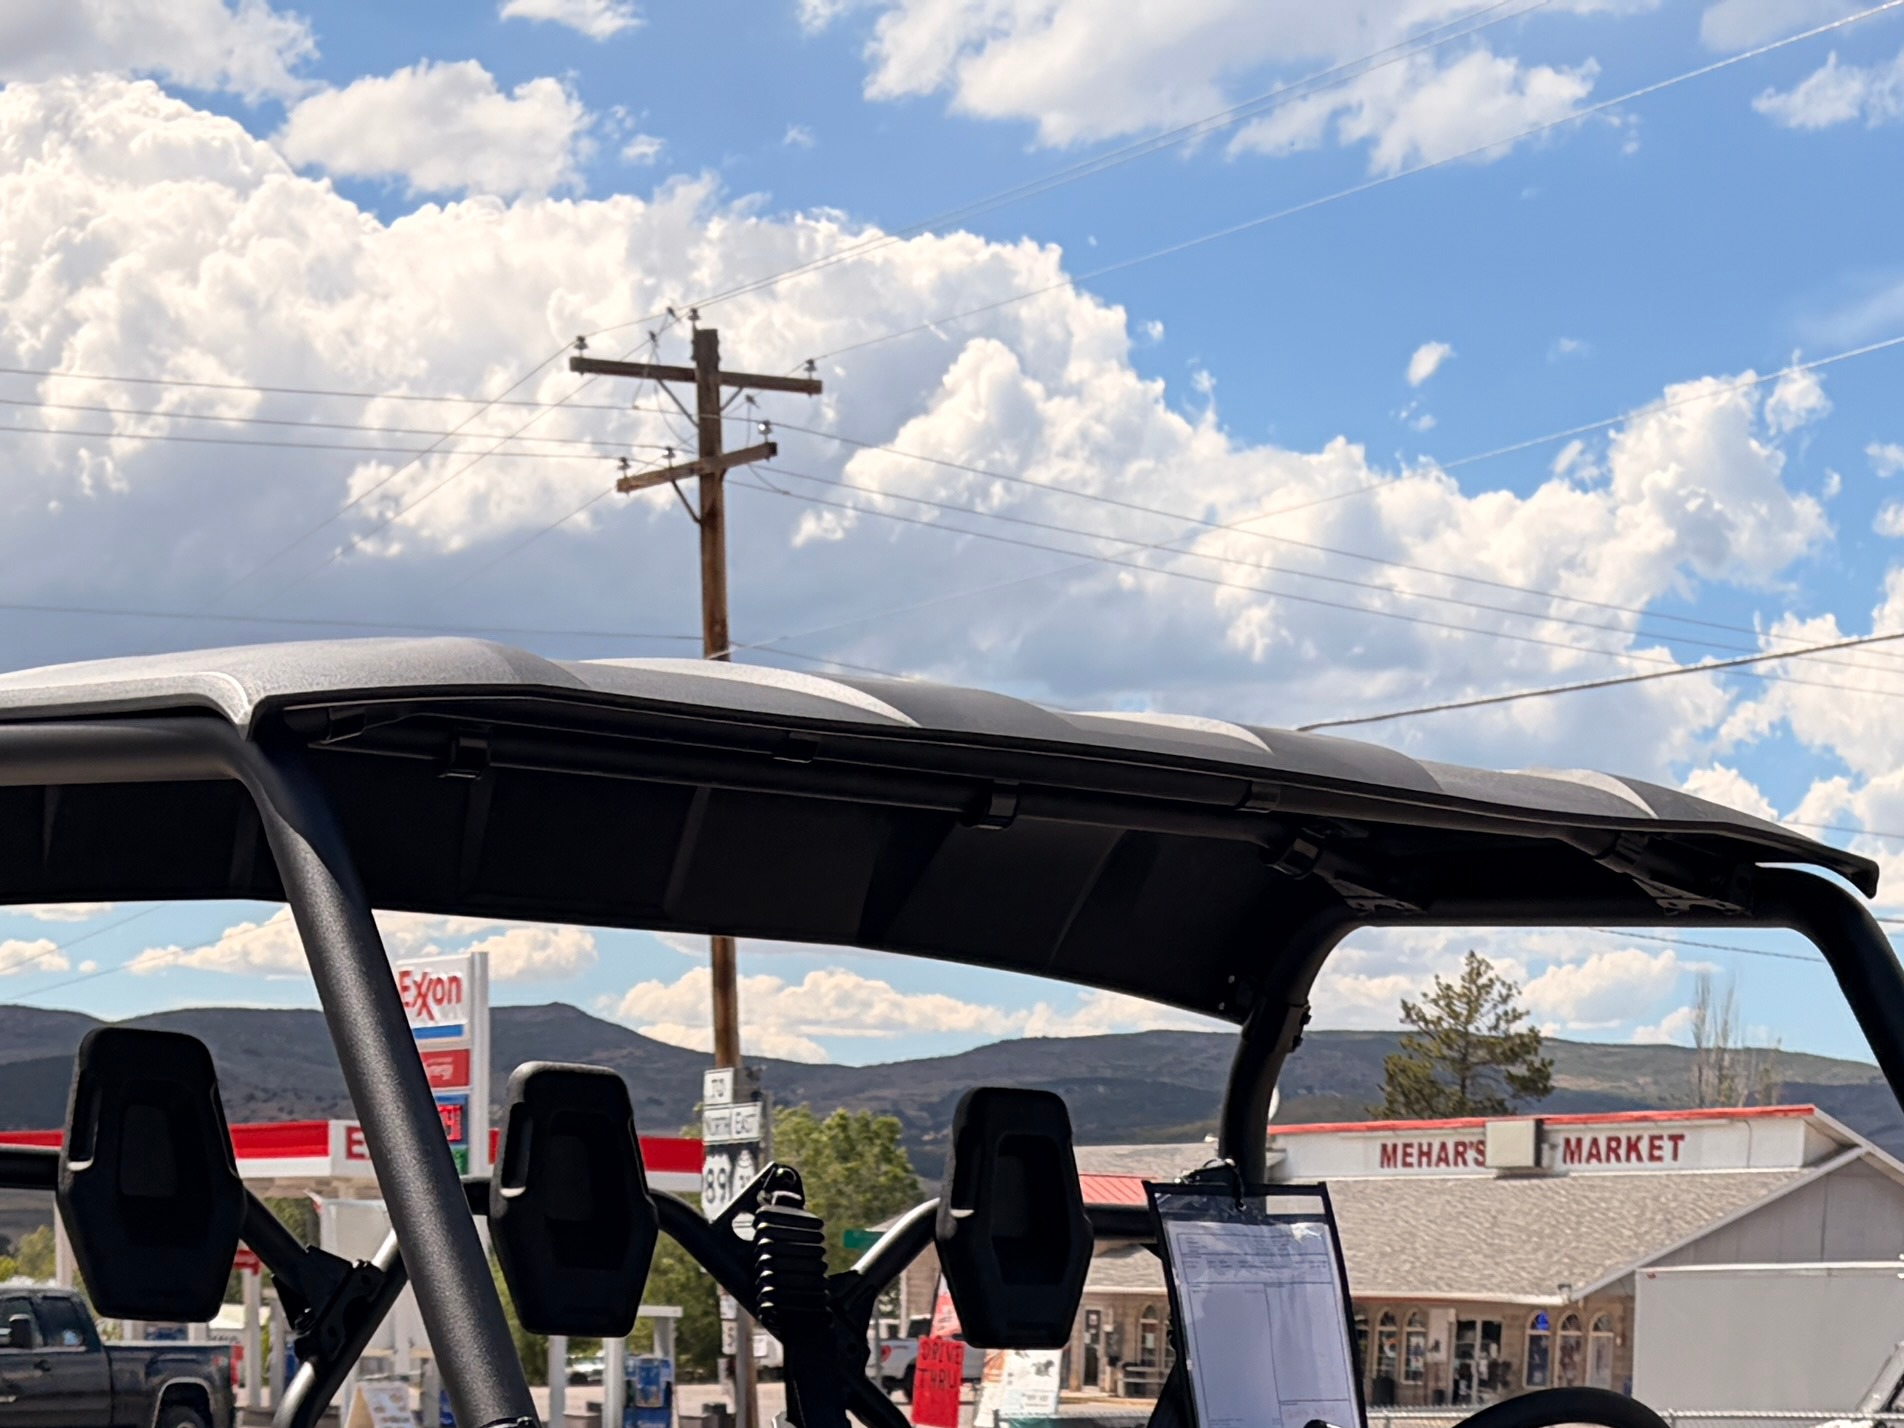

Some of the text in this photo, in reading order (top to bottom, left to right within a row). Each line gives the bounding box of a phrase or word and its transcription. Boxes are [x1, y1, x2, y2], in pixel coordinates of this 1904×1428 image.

[1380, 1133, 1685, 1169] MEHAR'S MARKET
[705, 1167, 728, 1205] 89
[921, 1338, 965, 1366] DRIVE
[918, 1368, 960, 1391] THRU
